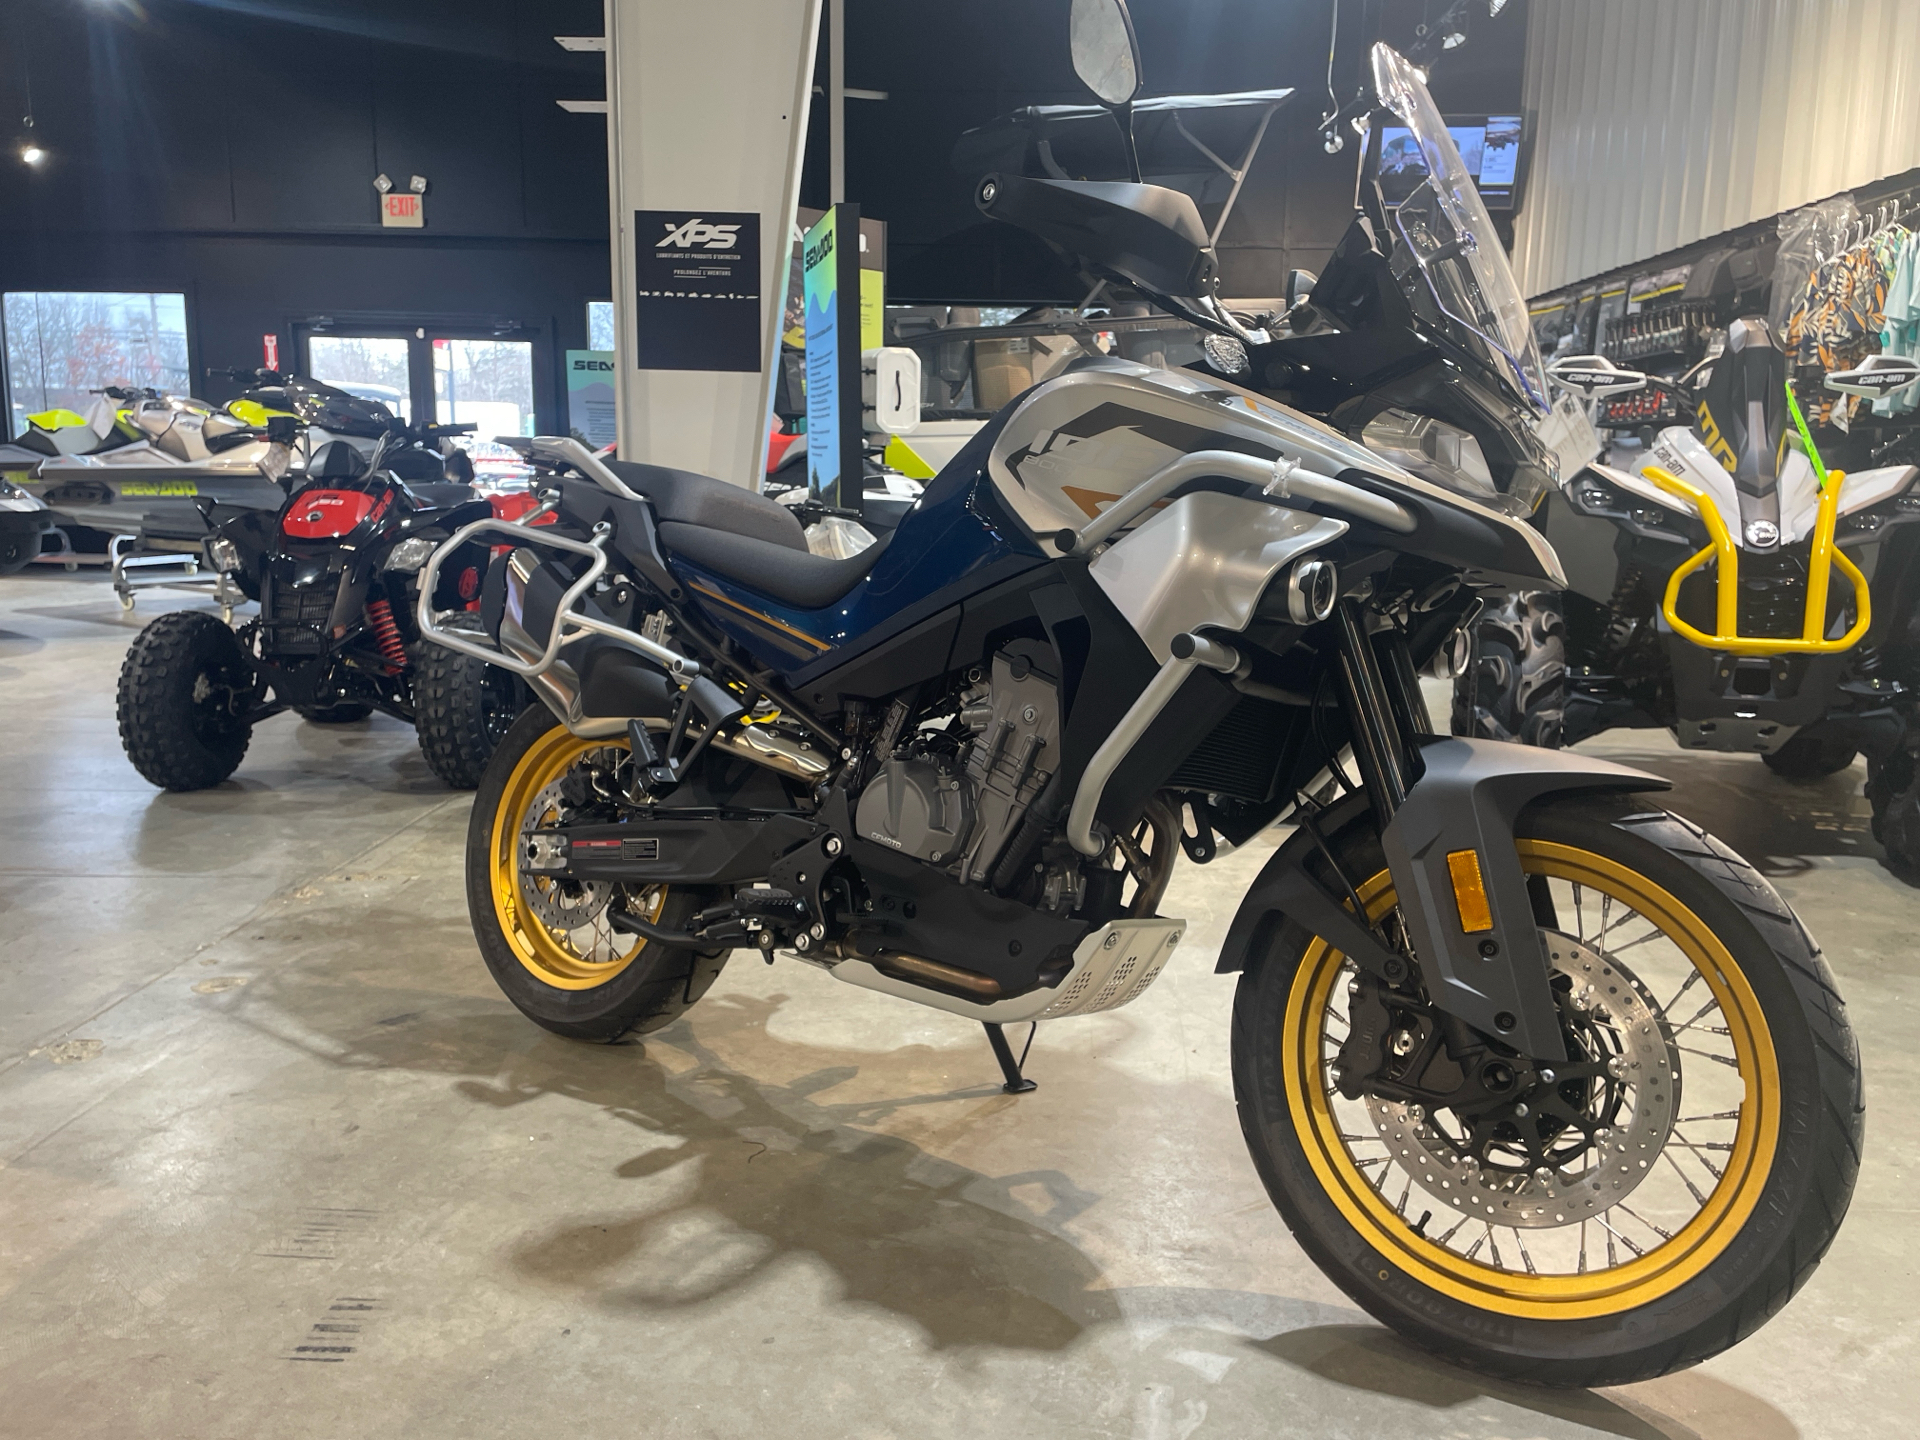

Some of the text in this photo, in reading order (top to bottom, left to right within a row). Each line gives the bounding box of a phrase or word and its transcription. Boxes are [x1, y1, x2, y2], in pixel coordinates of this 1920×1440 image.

[389, 196, 415, 217] EXIT
[655, 218, 742, 249] XPS
[871, 831, 902, 849] CFMOTO
